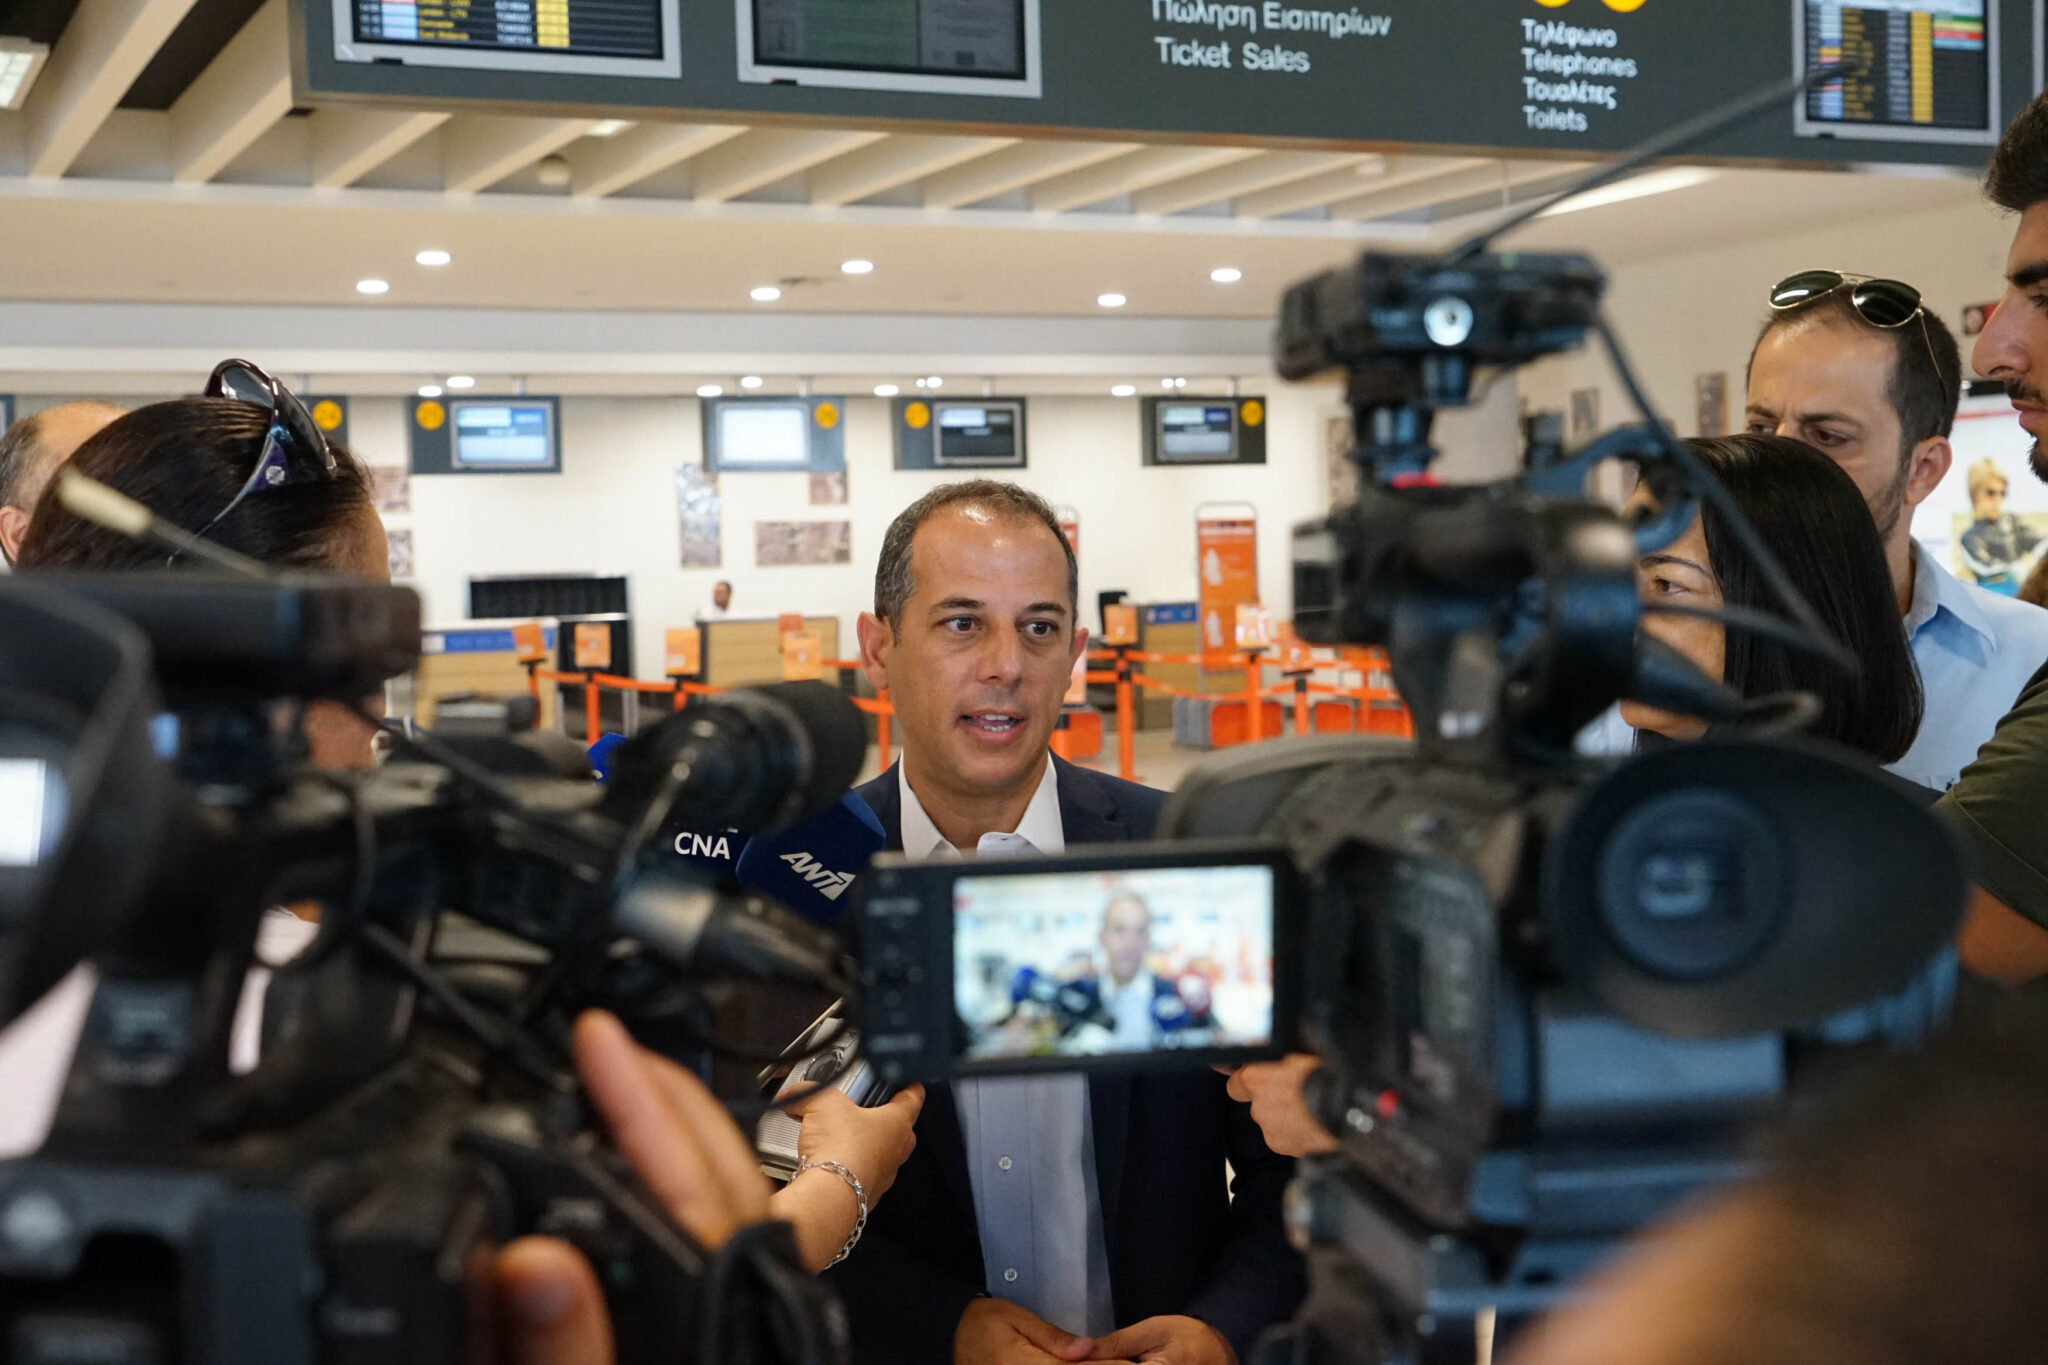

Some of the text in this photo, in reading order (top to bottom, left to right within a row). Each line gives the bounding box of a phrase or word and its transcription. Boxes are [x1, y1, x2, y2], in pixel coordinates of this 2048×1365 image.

[1154, 36, 1311, 73] Ticket Sales
[1521, 47, 1638, 78] Telephones
[1522, 76, 1618, 110] Τουαλέτες
[1522, 105, 1588, 132] Toilets
[674, 831, 731, 860] CNA
